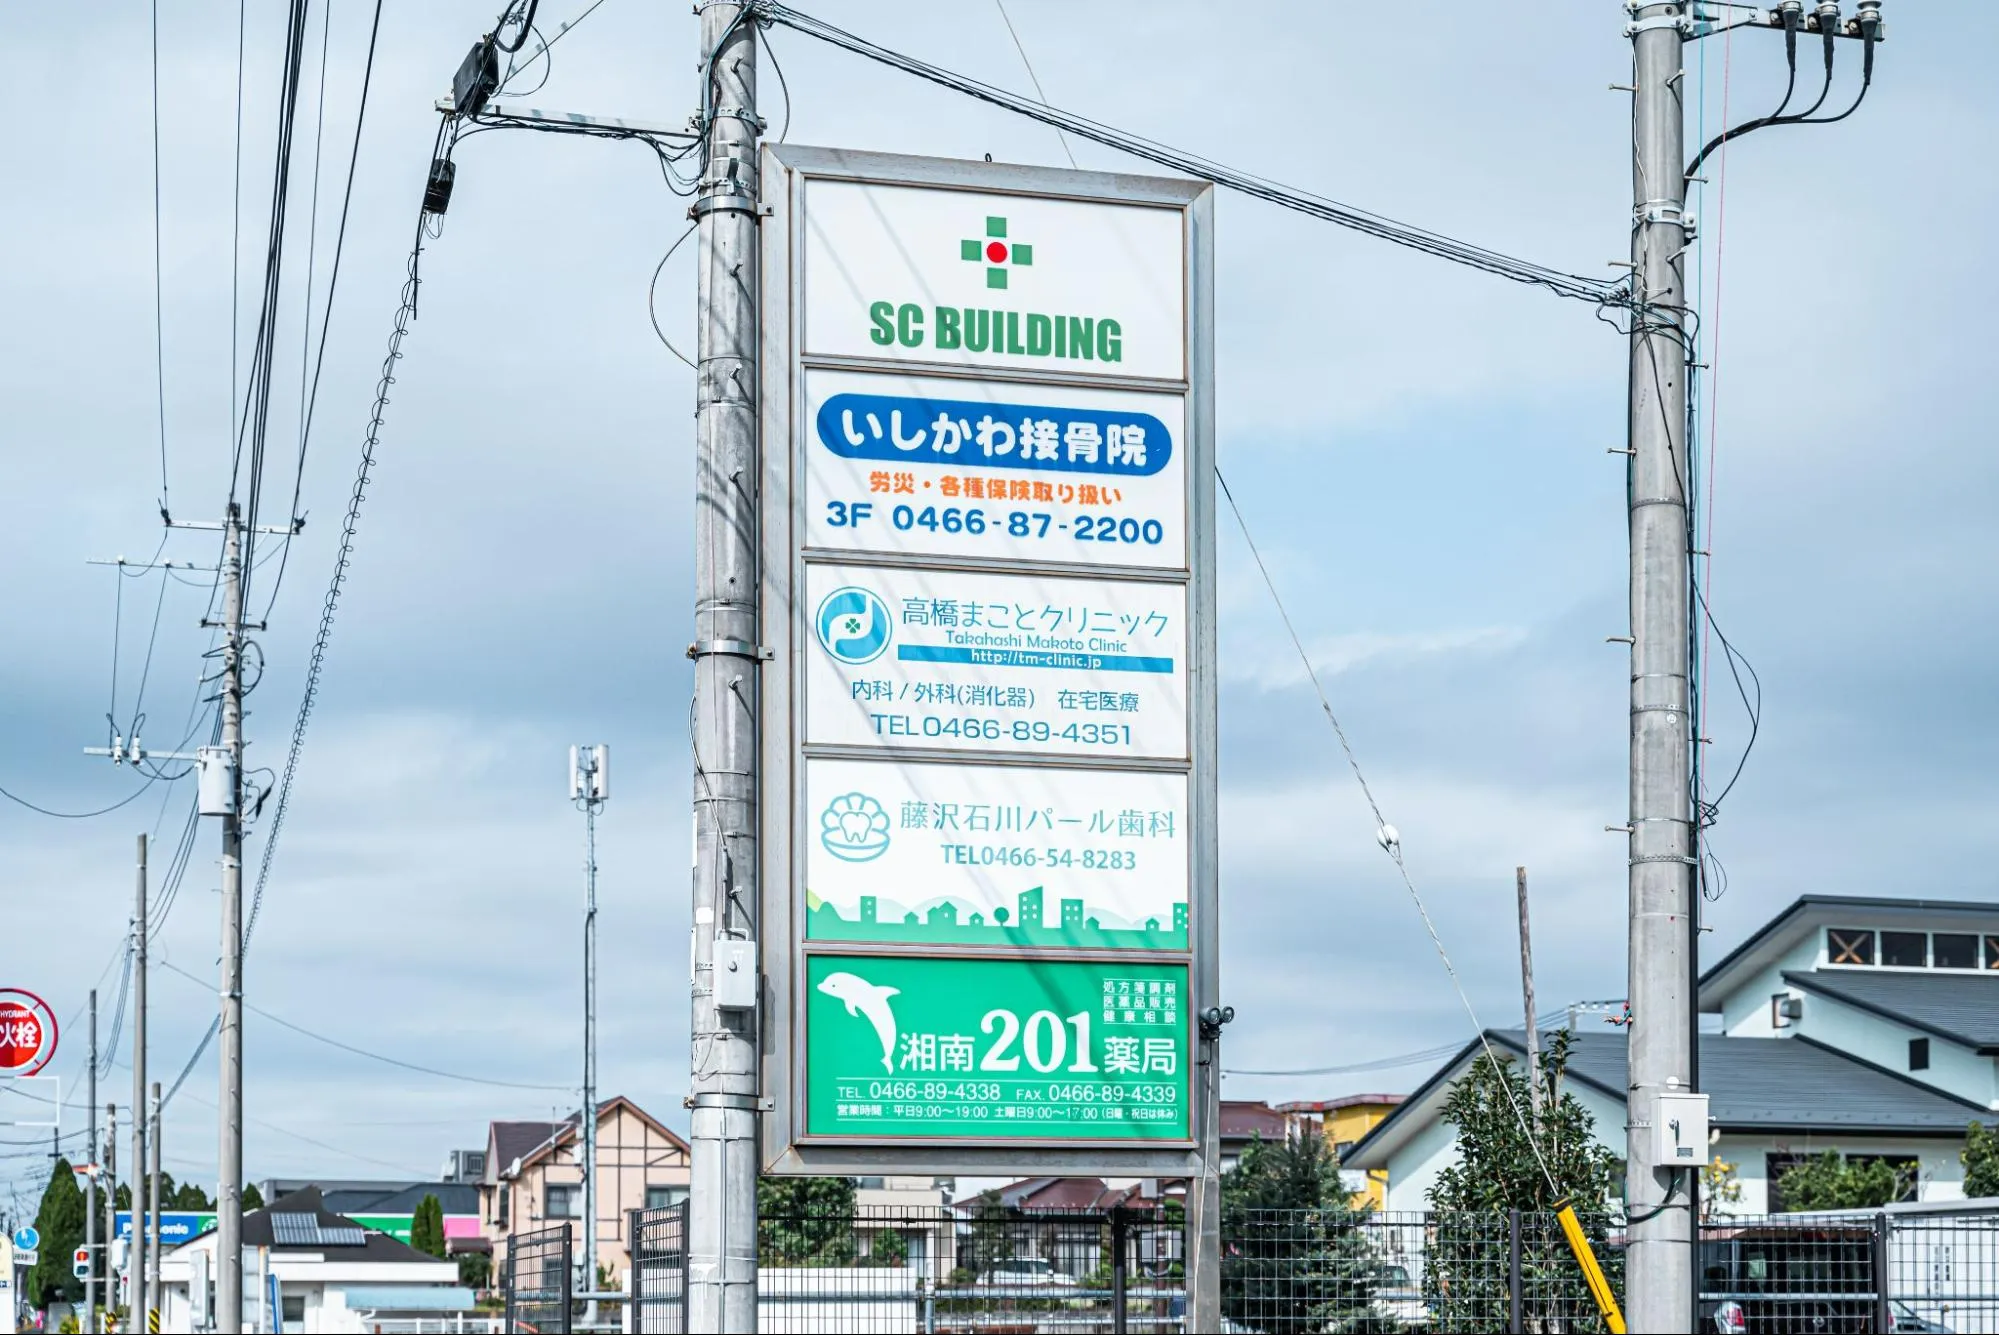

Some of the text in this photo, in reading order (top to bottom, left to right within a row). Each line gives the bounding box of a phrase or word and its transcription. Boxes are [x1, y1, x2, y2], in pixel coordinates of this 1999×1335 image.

[870, 302, 1121, 362] SC BUILDING
[842, 408, 1147, 466] いしかわ接骨院
[869, 472, 1122, 505] 労災・各種保険取り扱い
[826, 500, 873, 528] 3F
[902, 597, 1168, 636] 高橋まことクリニック
[945, 630, 1128, 653] Takahashi Makoto Clinic
[972, 650, 1102, 669] http://tm-clinic.jp
[1058, 689, 1139, 712] 在宅医療
[900, 801, 1176, 838] 藤沢石川パール歯科
[870, 1082, 1000, 1103] 0466-89-4338
[1049, 1085, 1175, 1102] 0466-89-4339
